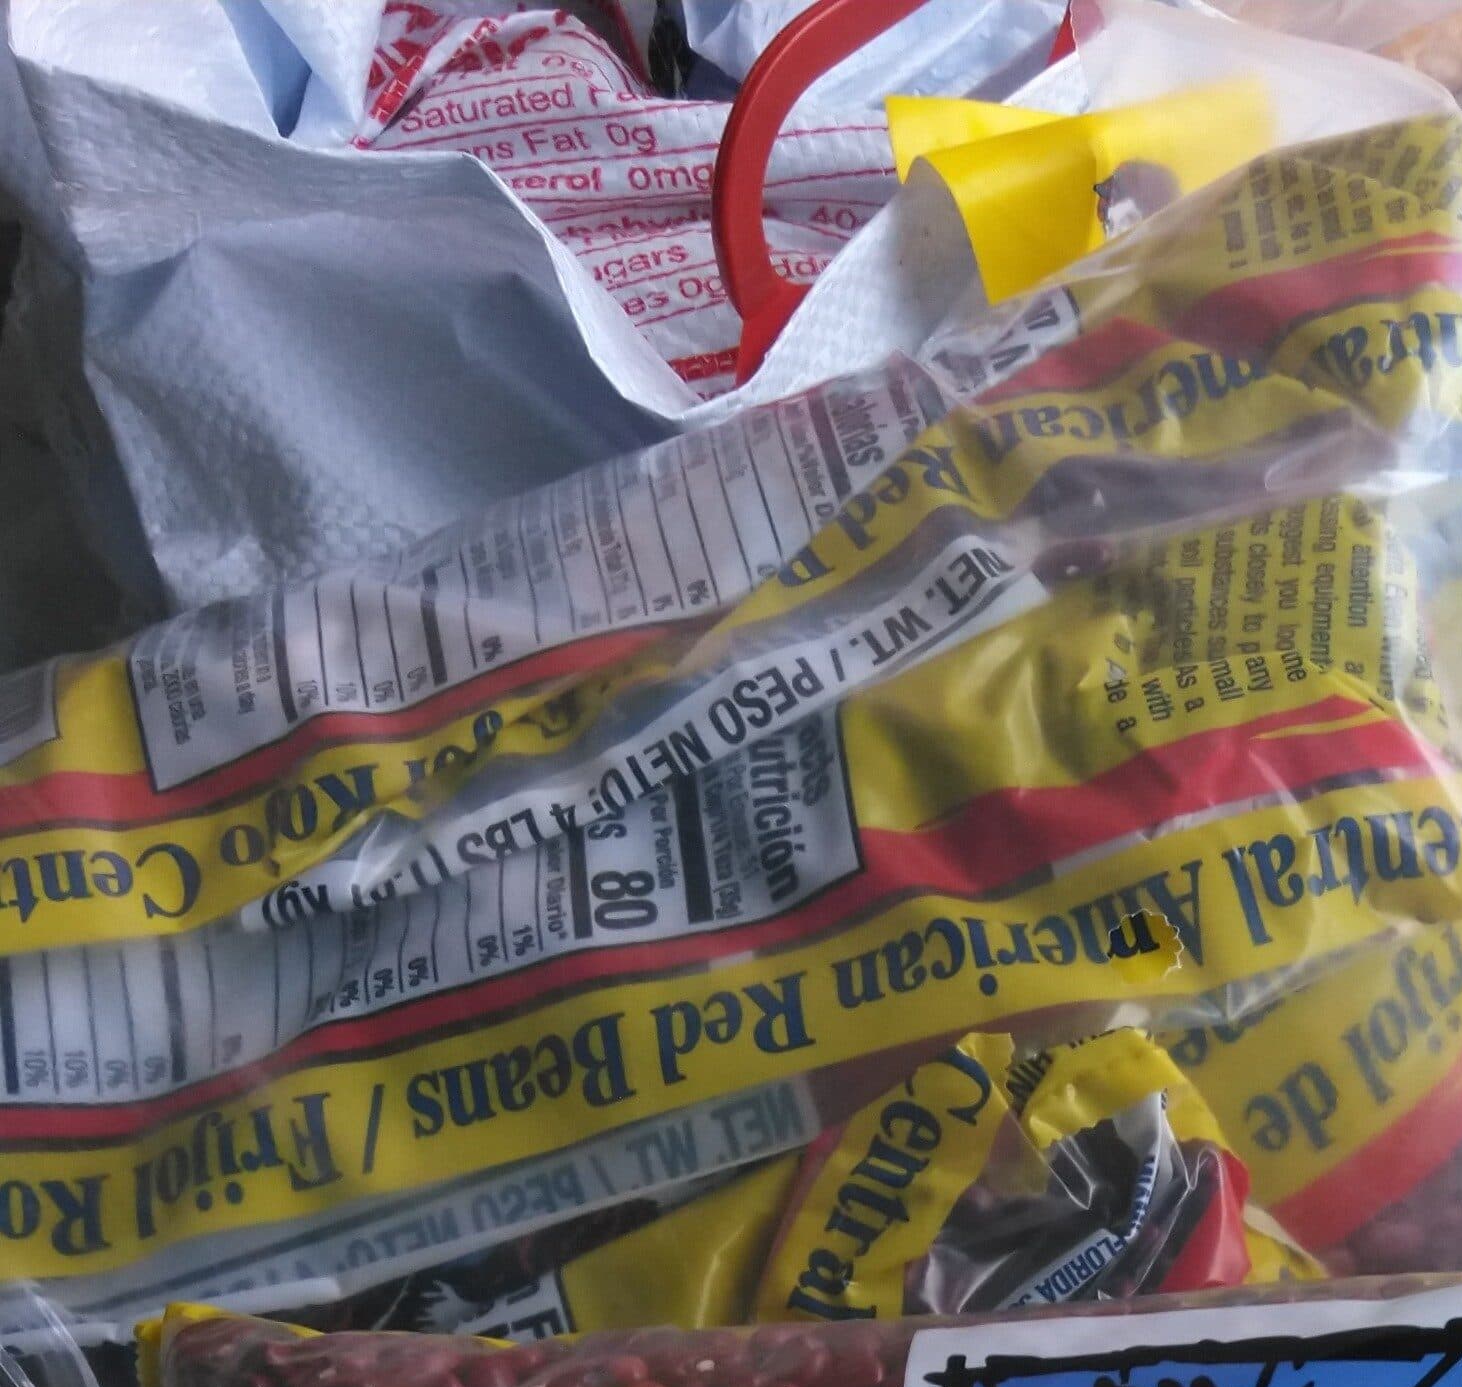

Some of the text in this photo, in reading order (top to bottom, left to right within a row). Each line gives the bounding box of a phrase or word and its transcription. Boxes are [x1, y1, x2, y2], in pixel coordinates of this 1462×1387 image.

[401, 83, 574, 133] Saturated
[522, 127, 592, 154] Fat
[605, 122, 657, 154] 0g
[849, 606, 932, 667] WT.
[1245, 655, 1274, 691] any
[706, 657, 825, 746] PESO
[1143, 677, 1175, 721] with
[588, 720, 714, 818] NETO:
[751, 736, 807, 903] utrición
[0, 841, 200, 923] Cent
[590, 870, 661, 931] 80
[830, 861, 1204, 1010] American
[651, 969, 817, 1087] Red
[407, 1029, 636, 1138] Beans
[133, 1090, 344, 1219] Frijol
[361, 1083, 386, 1176] /
[0, 1178, 115, 1258] Ro
[1035, 1234, 1128, 1302] FLORIDA
